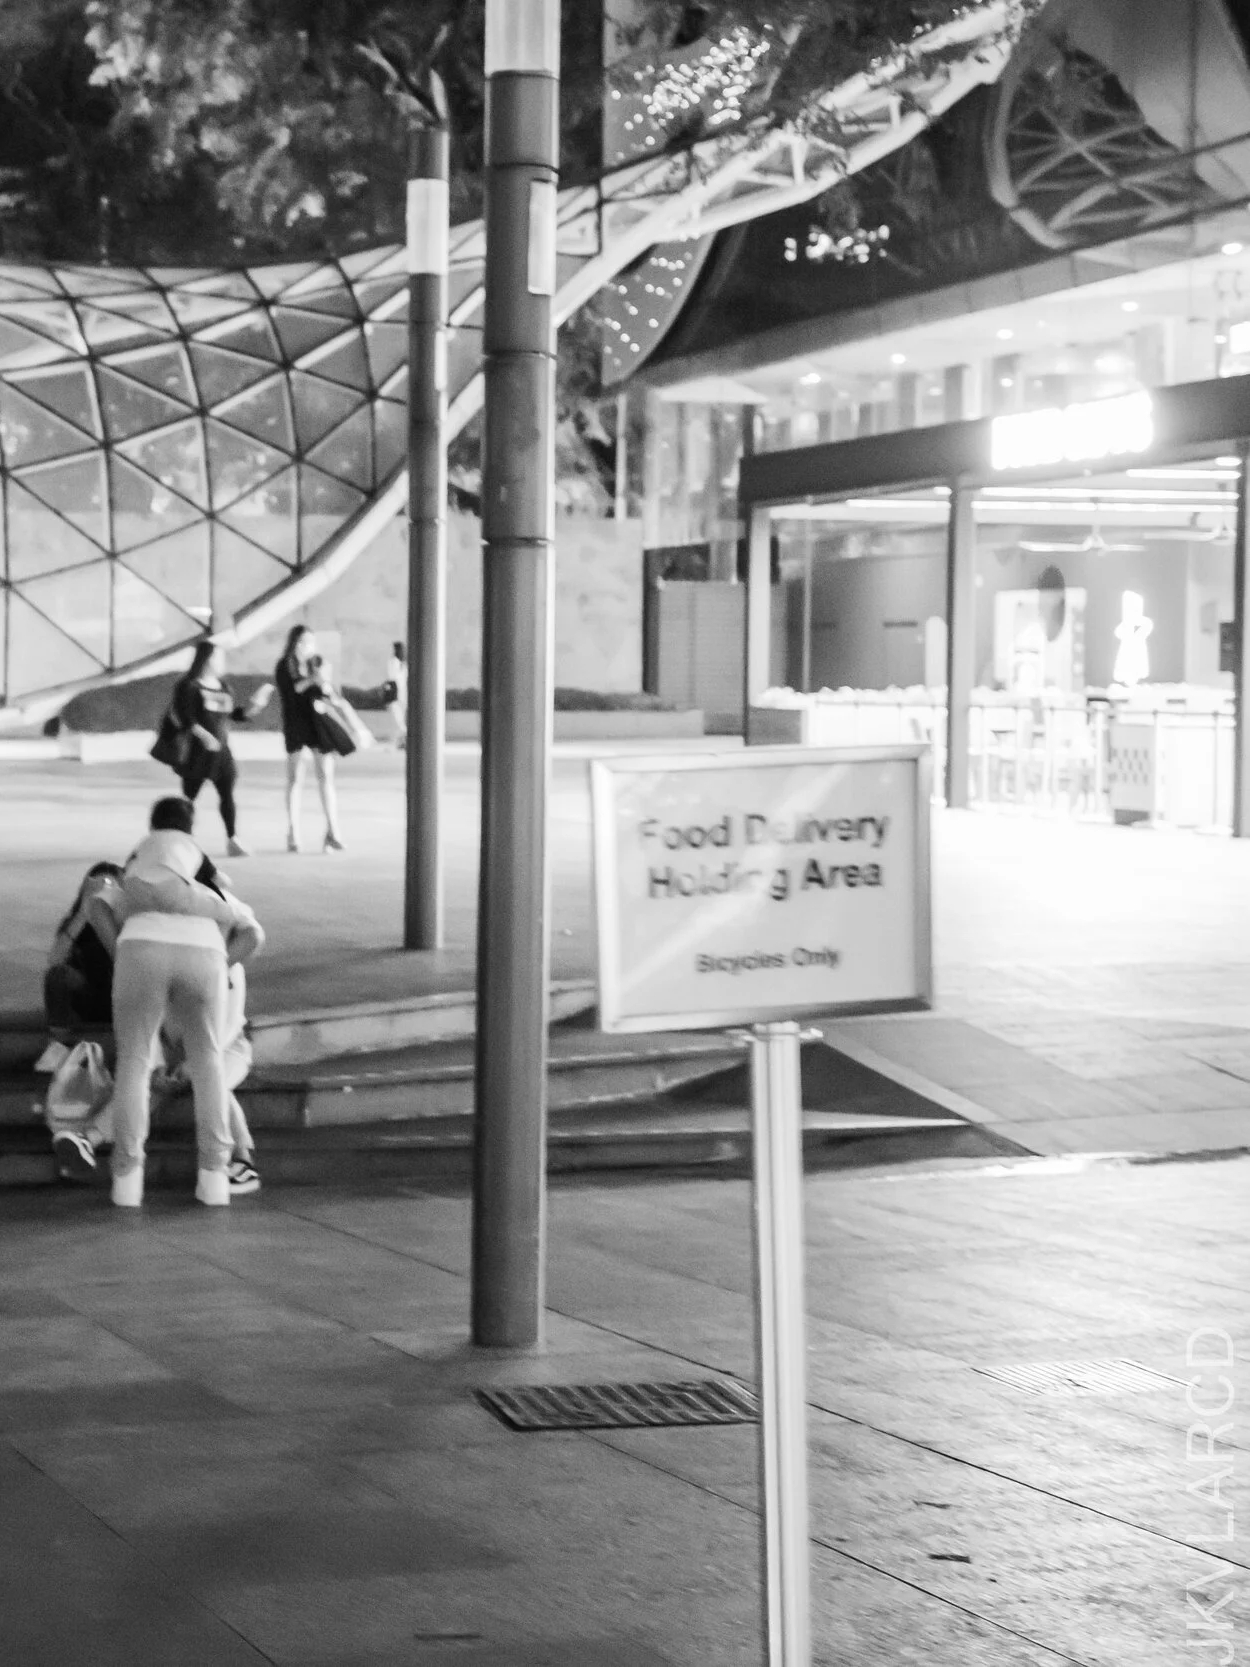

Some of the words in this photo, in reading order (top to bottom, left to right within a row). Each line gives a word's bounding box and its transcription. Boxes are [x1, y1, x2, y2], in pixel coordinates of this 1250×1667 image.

[639, 815, 732, 850] Food
[802, 858, 882, 890] Area
[696, 951, 787, 976] Bicycles
[792, 946, 841, 970] Only
